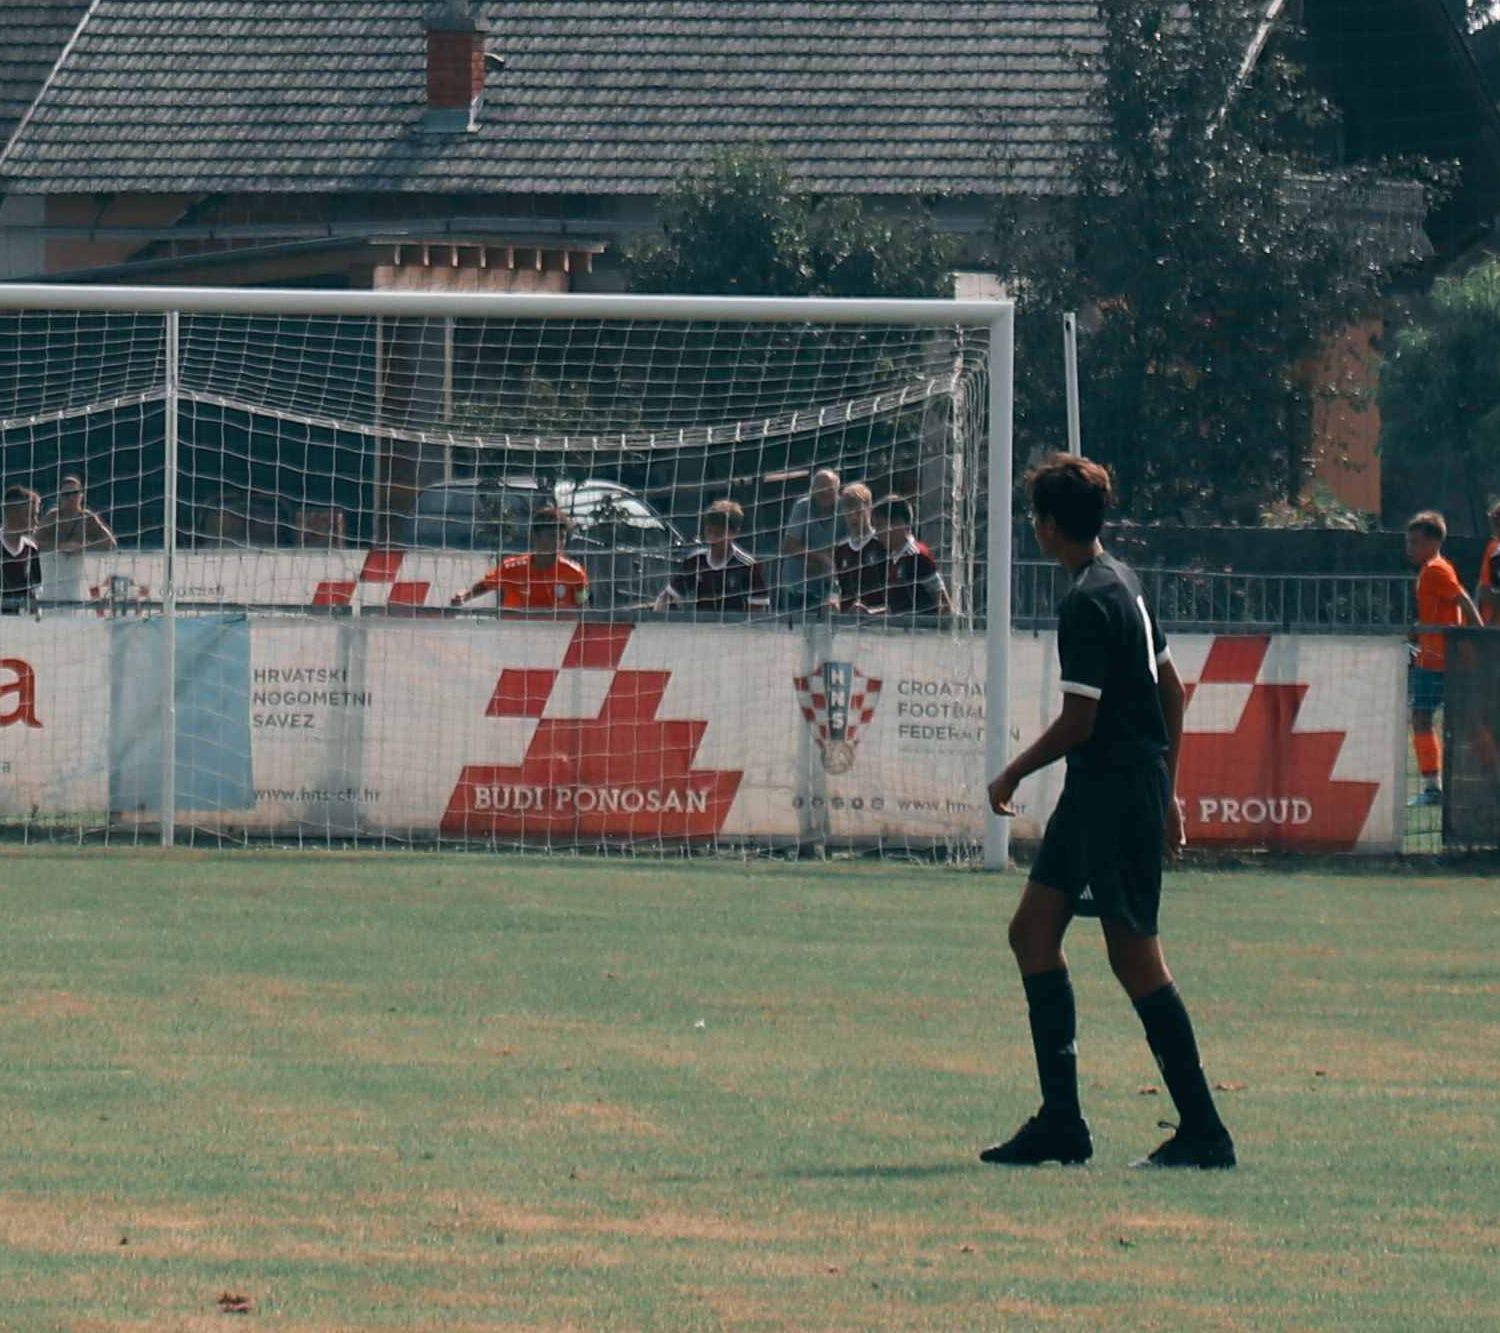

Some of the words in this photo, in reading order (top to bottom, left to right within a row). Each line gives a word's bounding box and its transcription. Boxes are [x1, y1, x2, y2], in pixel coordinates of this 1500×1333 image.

[253, 668, 348, 683] HRVATSKI
[897, 681, 985, 696] CROATIA
[253, 692, 373, 708] NOGOMETNI
[830, 669, 846, 729] HNS
[898, 703, 986, 719] FOOTBAL
[253, 714, 316, 729] SAVEZ
[474, 786, 544, 811] BUDI
[555, 788, 709, 814] PONOSAN
[1200, 797, 1312, 825] PROUD
